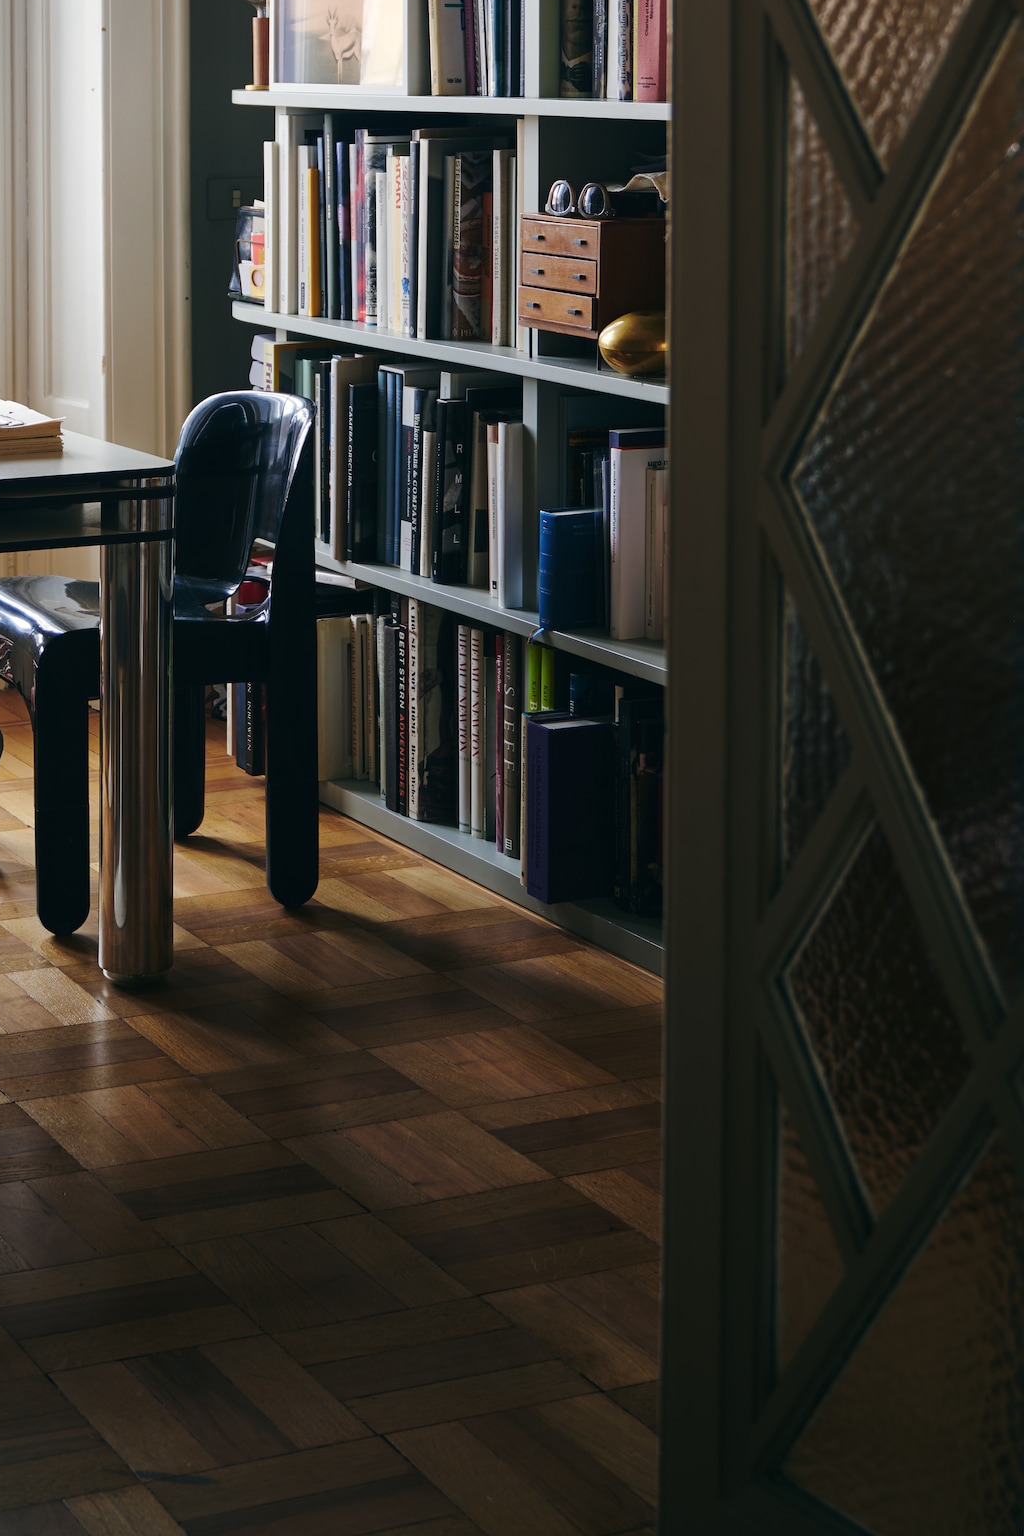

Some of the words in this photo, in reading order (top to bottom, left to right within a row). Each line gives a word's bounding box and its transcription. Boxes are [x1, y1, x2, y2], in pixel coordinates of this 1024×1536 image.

[412, 443, 420, 469] Evans
[647, 460, 662, 469] ugo
[459, 632, 467, 692] HELMUT
[459, 695, 467, 752] NEWTON
[504, 683, 515, 772] SIEFF
